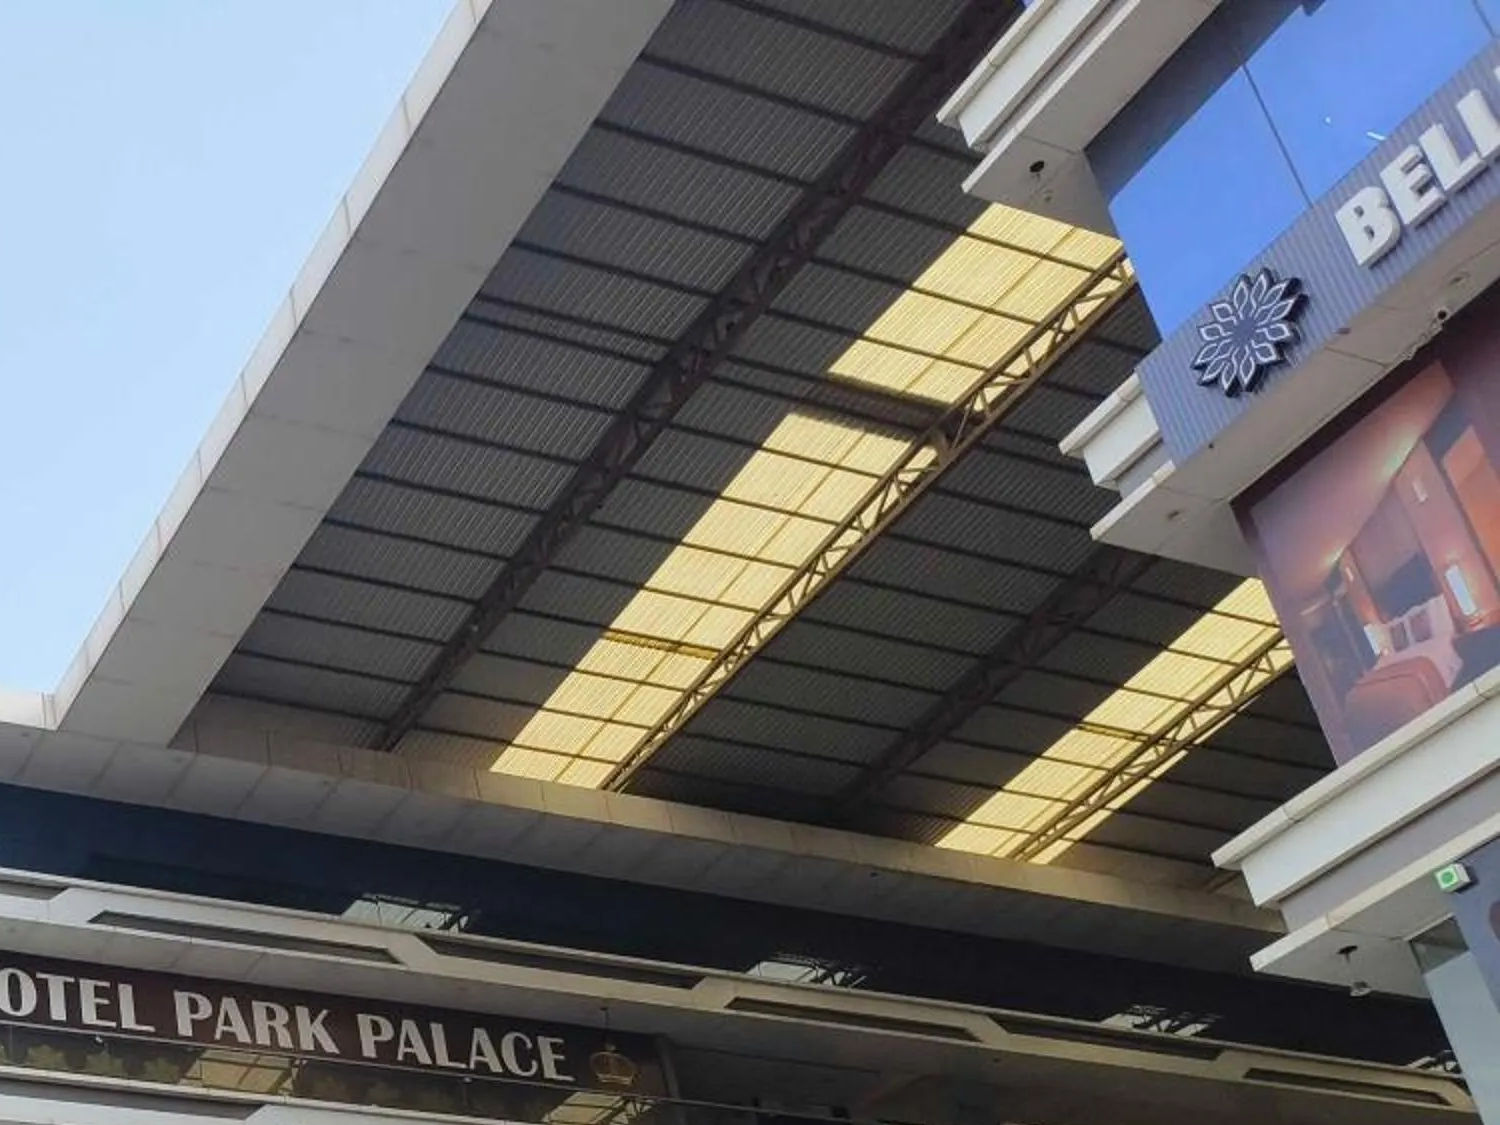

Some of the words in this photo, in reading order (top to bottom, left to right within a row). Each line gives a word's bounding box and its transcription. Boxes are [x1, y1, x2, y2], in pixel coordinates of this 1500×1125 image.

[1334, 65, 1500, 268] BELL
[173, 990, 341, 1056] PARK
[357, 1012, 576, 1082] PALACE
